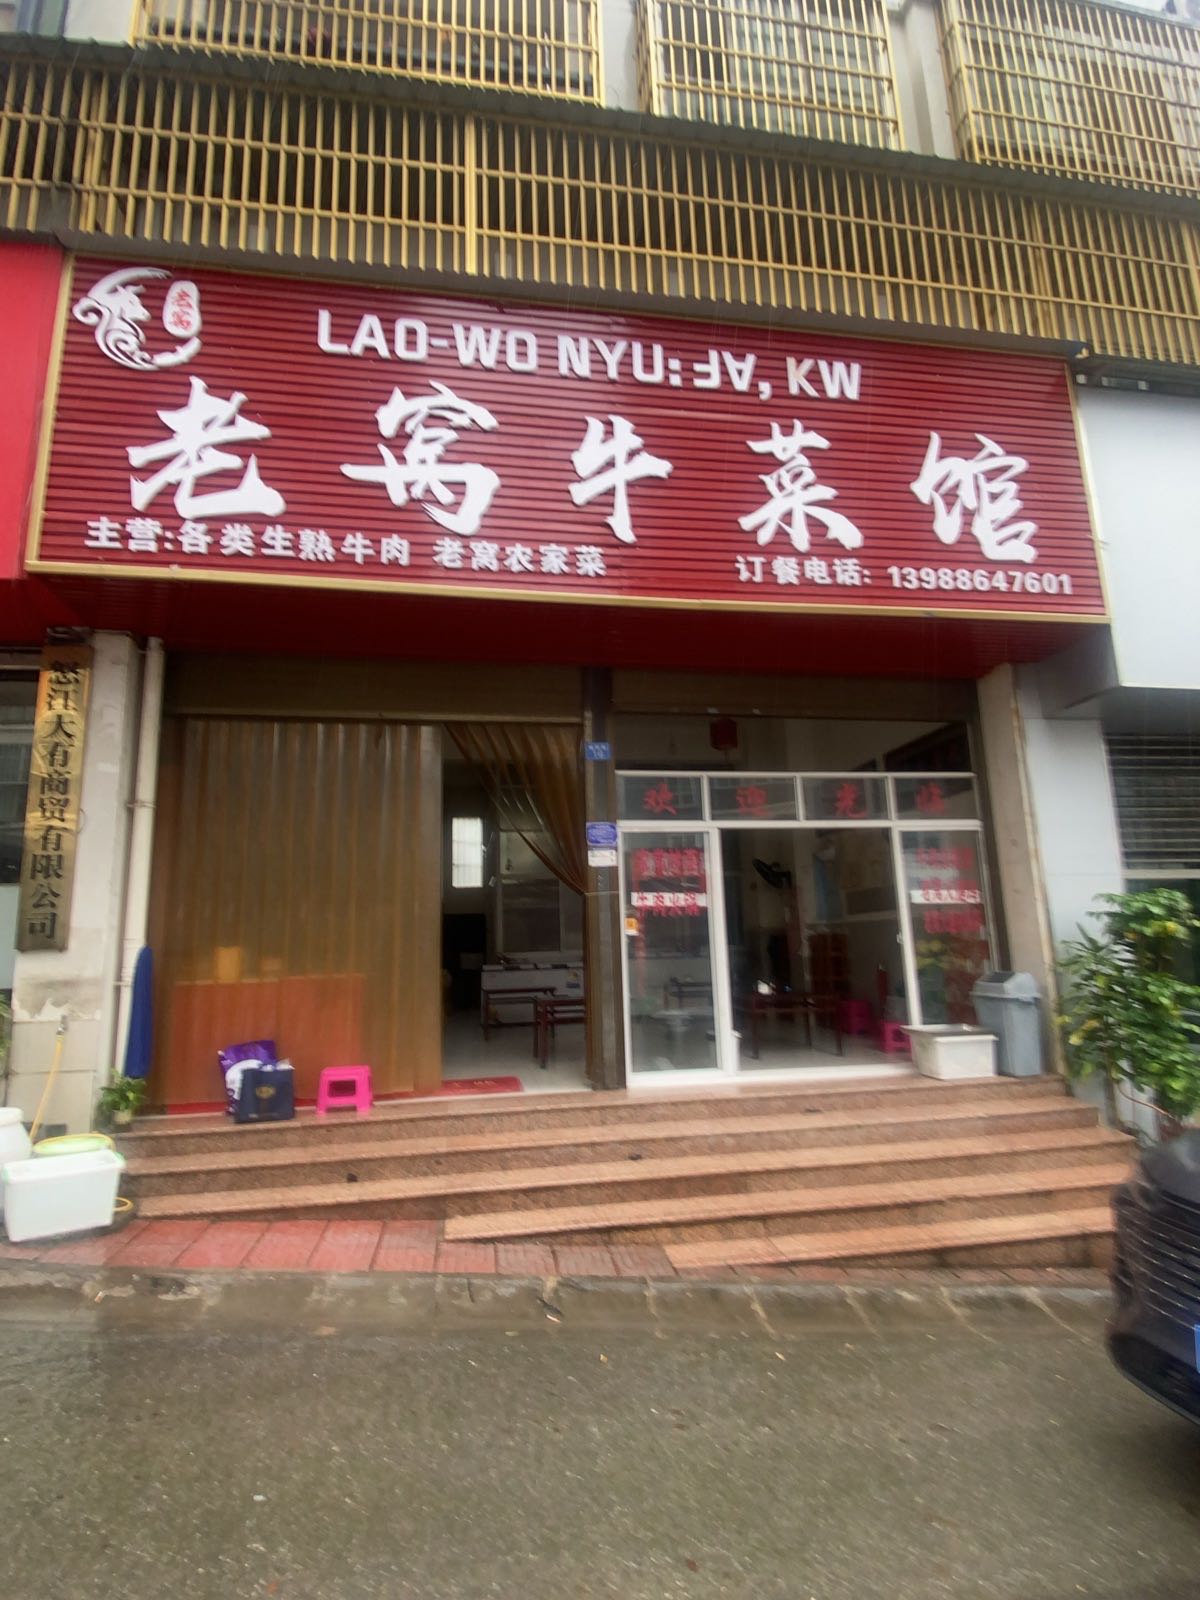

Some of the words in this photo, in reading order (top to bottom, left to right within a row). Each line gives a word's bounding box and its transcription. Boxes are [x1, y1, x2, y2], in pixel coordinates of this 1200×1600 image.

[317, 309, 539, 372] LAO-WO
[786, 356, 861, 401] KW
[126, 375, 1038, 564] 老窝牛菜馆
[432, 535, 608, 578] 老窝农家菜
[734, 554, 873, 587] 订餐电话:
[886, 565, 1074, 595] 13988647601
